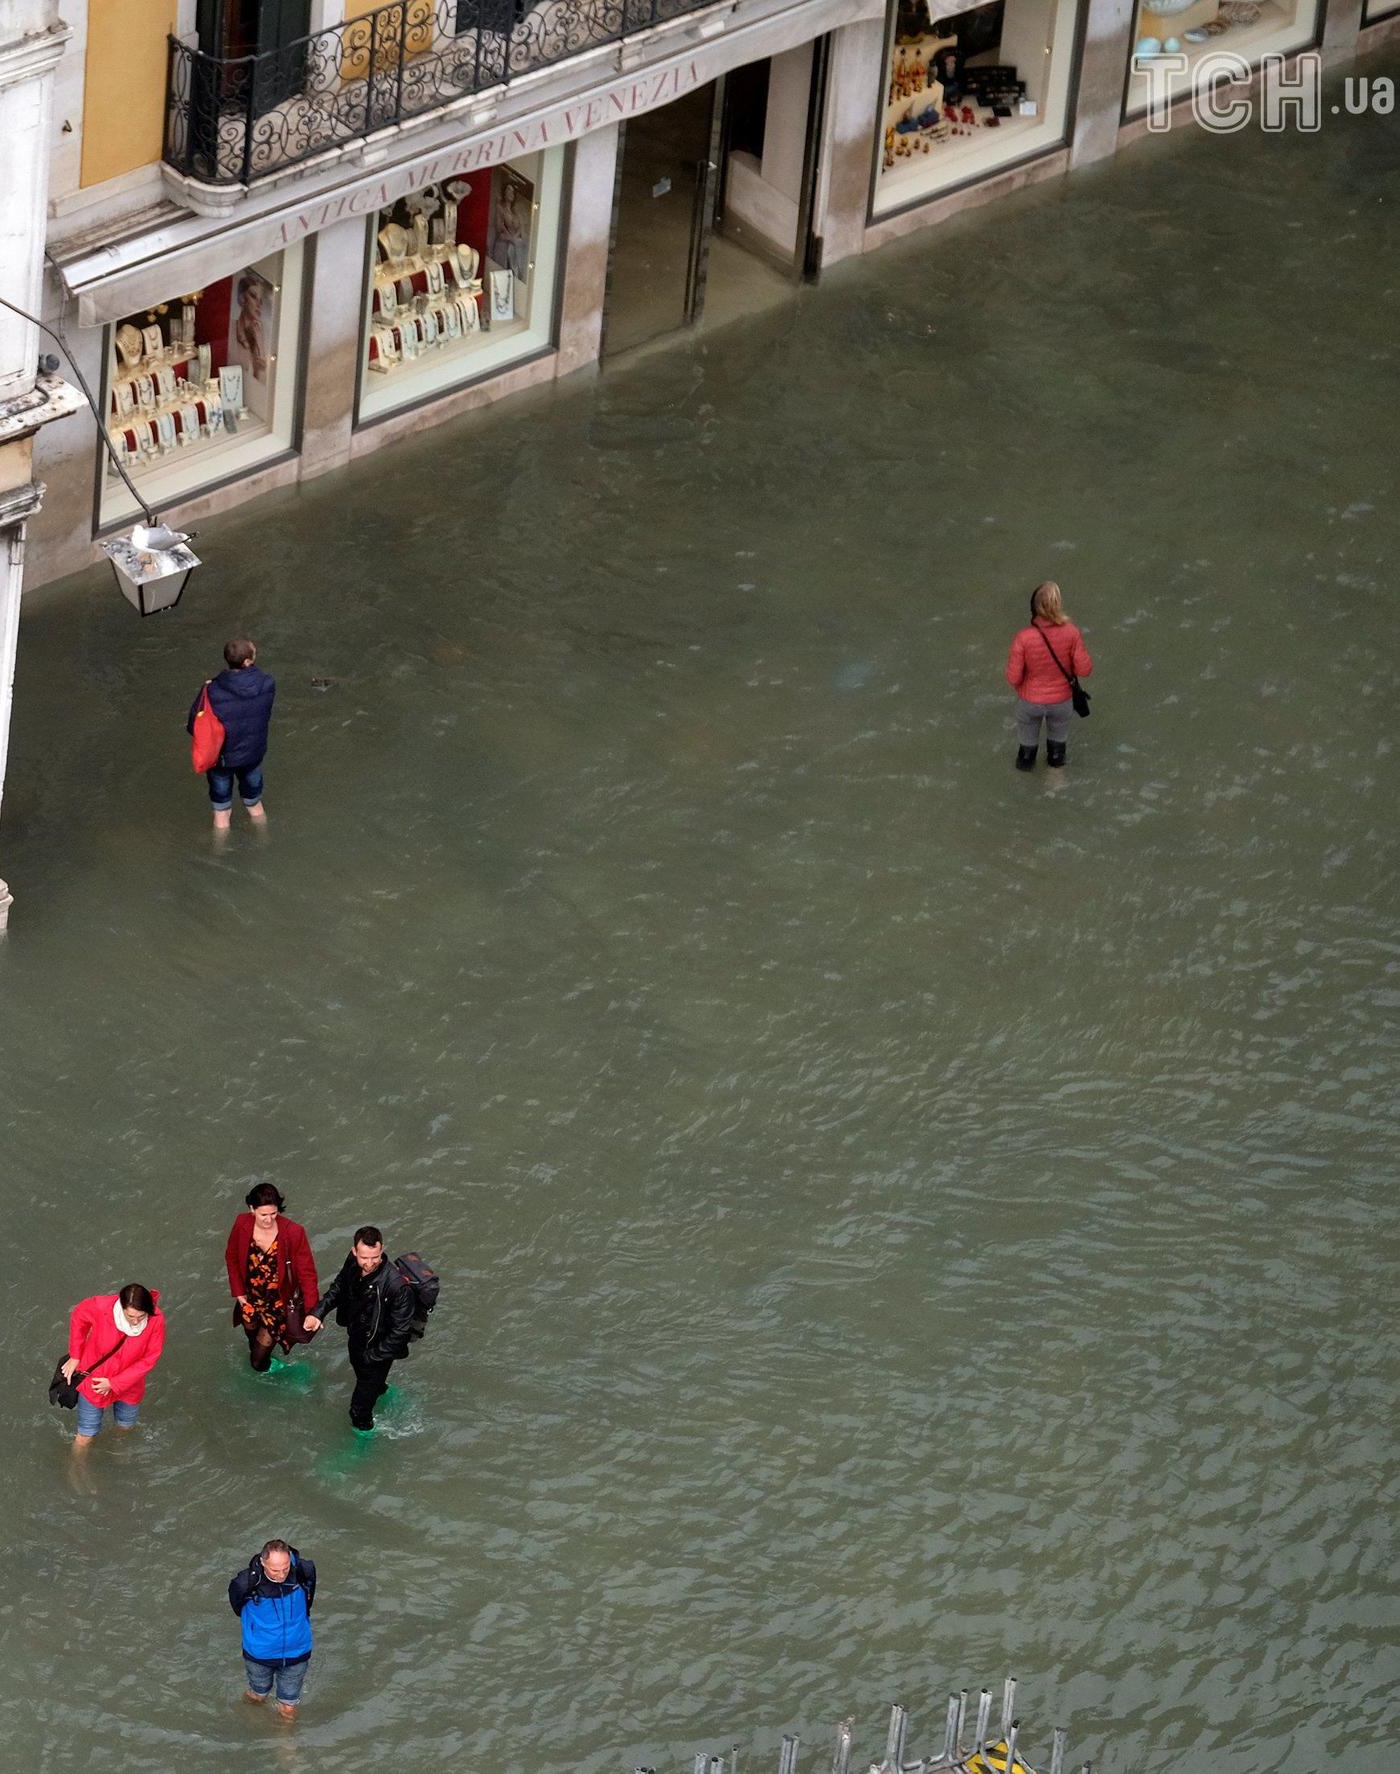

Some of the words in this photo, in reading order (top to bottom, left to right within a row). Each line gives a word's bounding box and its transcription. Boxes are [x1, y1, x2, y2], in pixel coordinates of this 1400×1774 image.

[269, 183, 389, 249] ANTICA
[403, 120, 549, 191] MURRINA
[563, 60, 699, 135] VENEZIA
